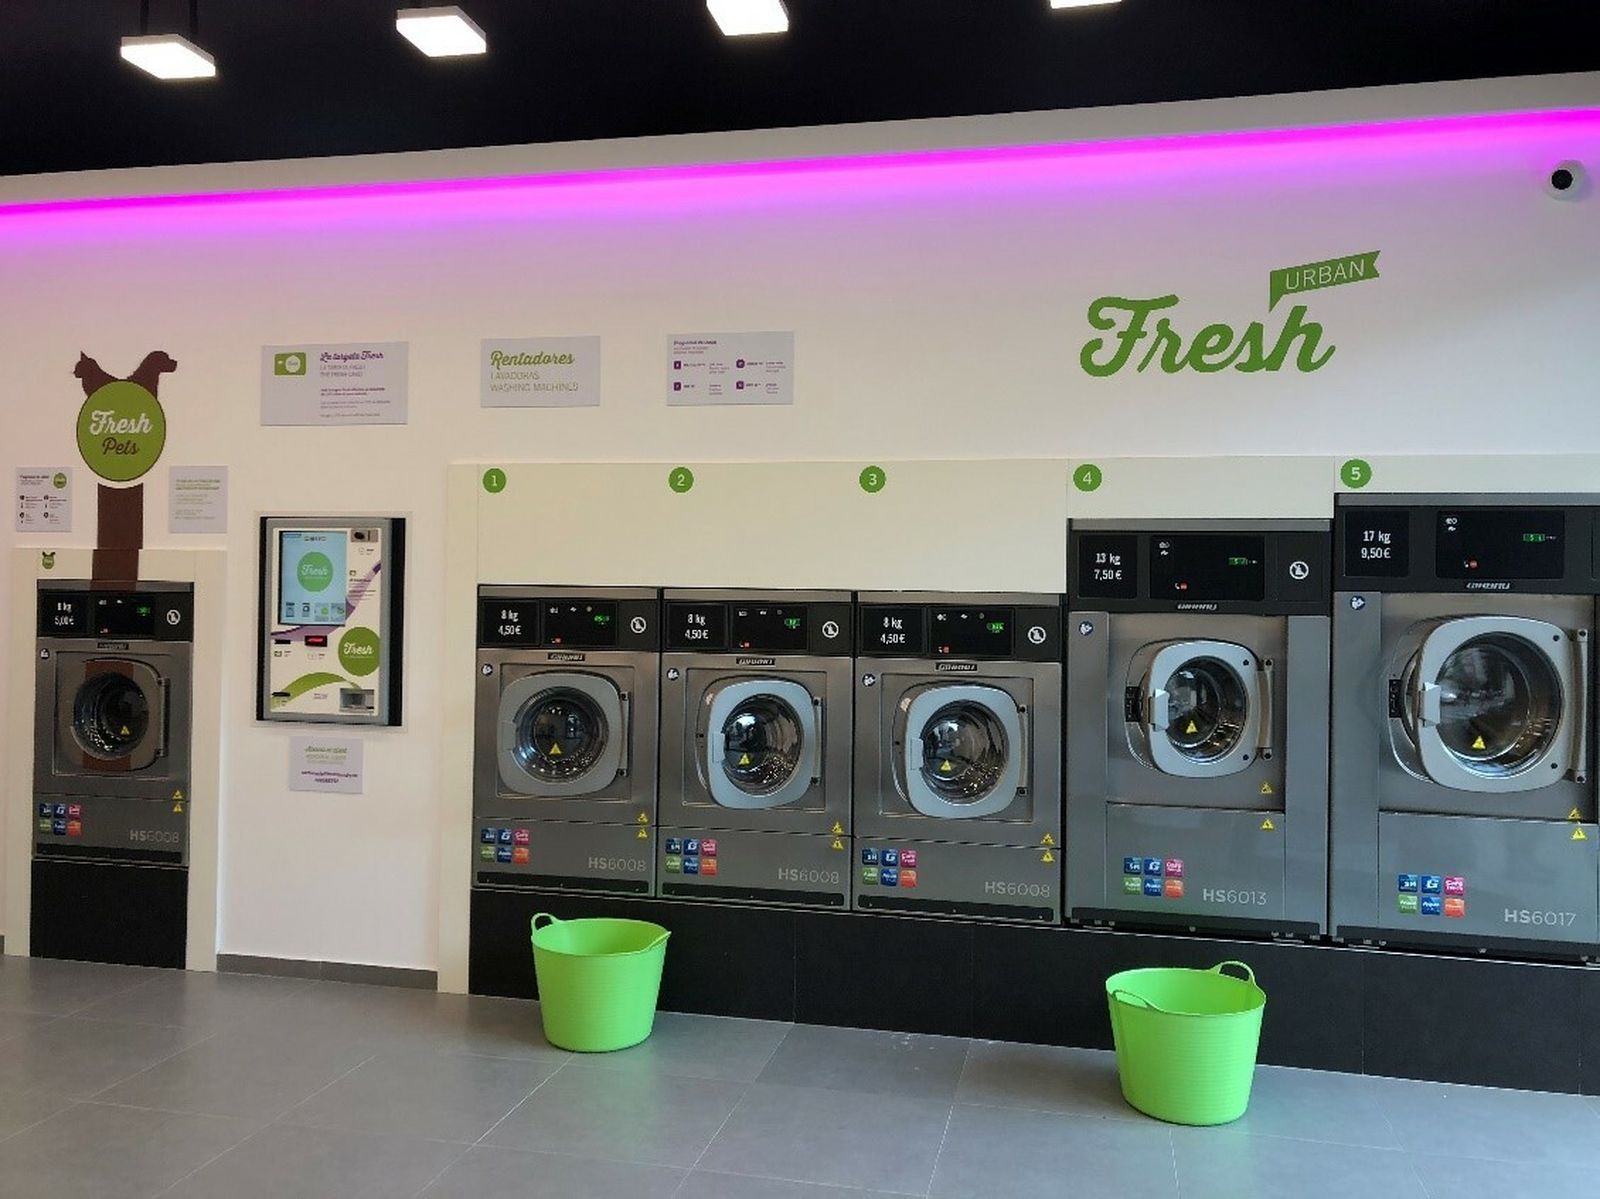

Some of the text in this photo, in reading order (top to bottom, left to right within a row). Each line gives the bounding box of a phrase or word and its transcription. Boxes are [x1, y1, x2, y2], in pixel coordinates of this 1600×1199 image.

[1285, 259, 1365, 290] URBAN
[1080, 294, 1336, 377] Fresh
[490, 350, 575, 370] Rentadores
[533, 382, 579, 392] MACHINES
[89, 410, 153, 435] Fresh
[102, 437, 140, 455] Pets
[491, 474, 498, 487] 1
[677, 474, 685, 486] 2
[868, 474, 877, 486] 3
[1082, 471, 1093, 484] 4
[1350, 467, 1361, 480] 5
[1362, 530, 1391, 544] 17 kg
[1095, 553, 1121, 566] 13 kg
[1360, 547, 1391, 560] 9,50€
[301, 565, 329, 576] Fresh
[501, 609, 519, 622] 8 kg
[344, 641, 375, 656] Fresh
[129, 830, 180, 843] HS6008
[588, 857, 647, 871] HS6008
[777, 868, 840, 884] HS6008
[984, 882, 1051, 898] HS6008
[1203, 888, 1266, 905] HS6013
[1504, 909, 1577, 926] HS6017
